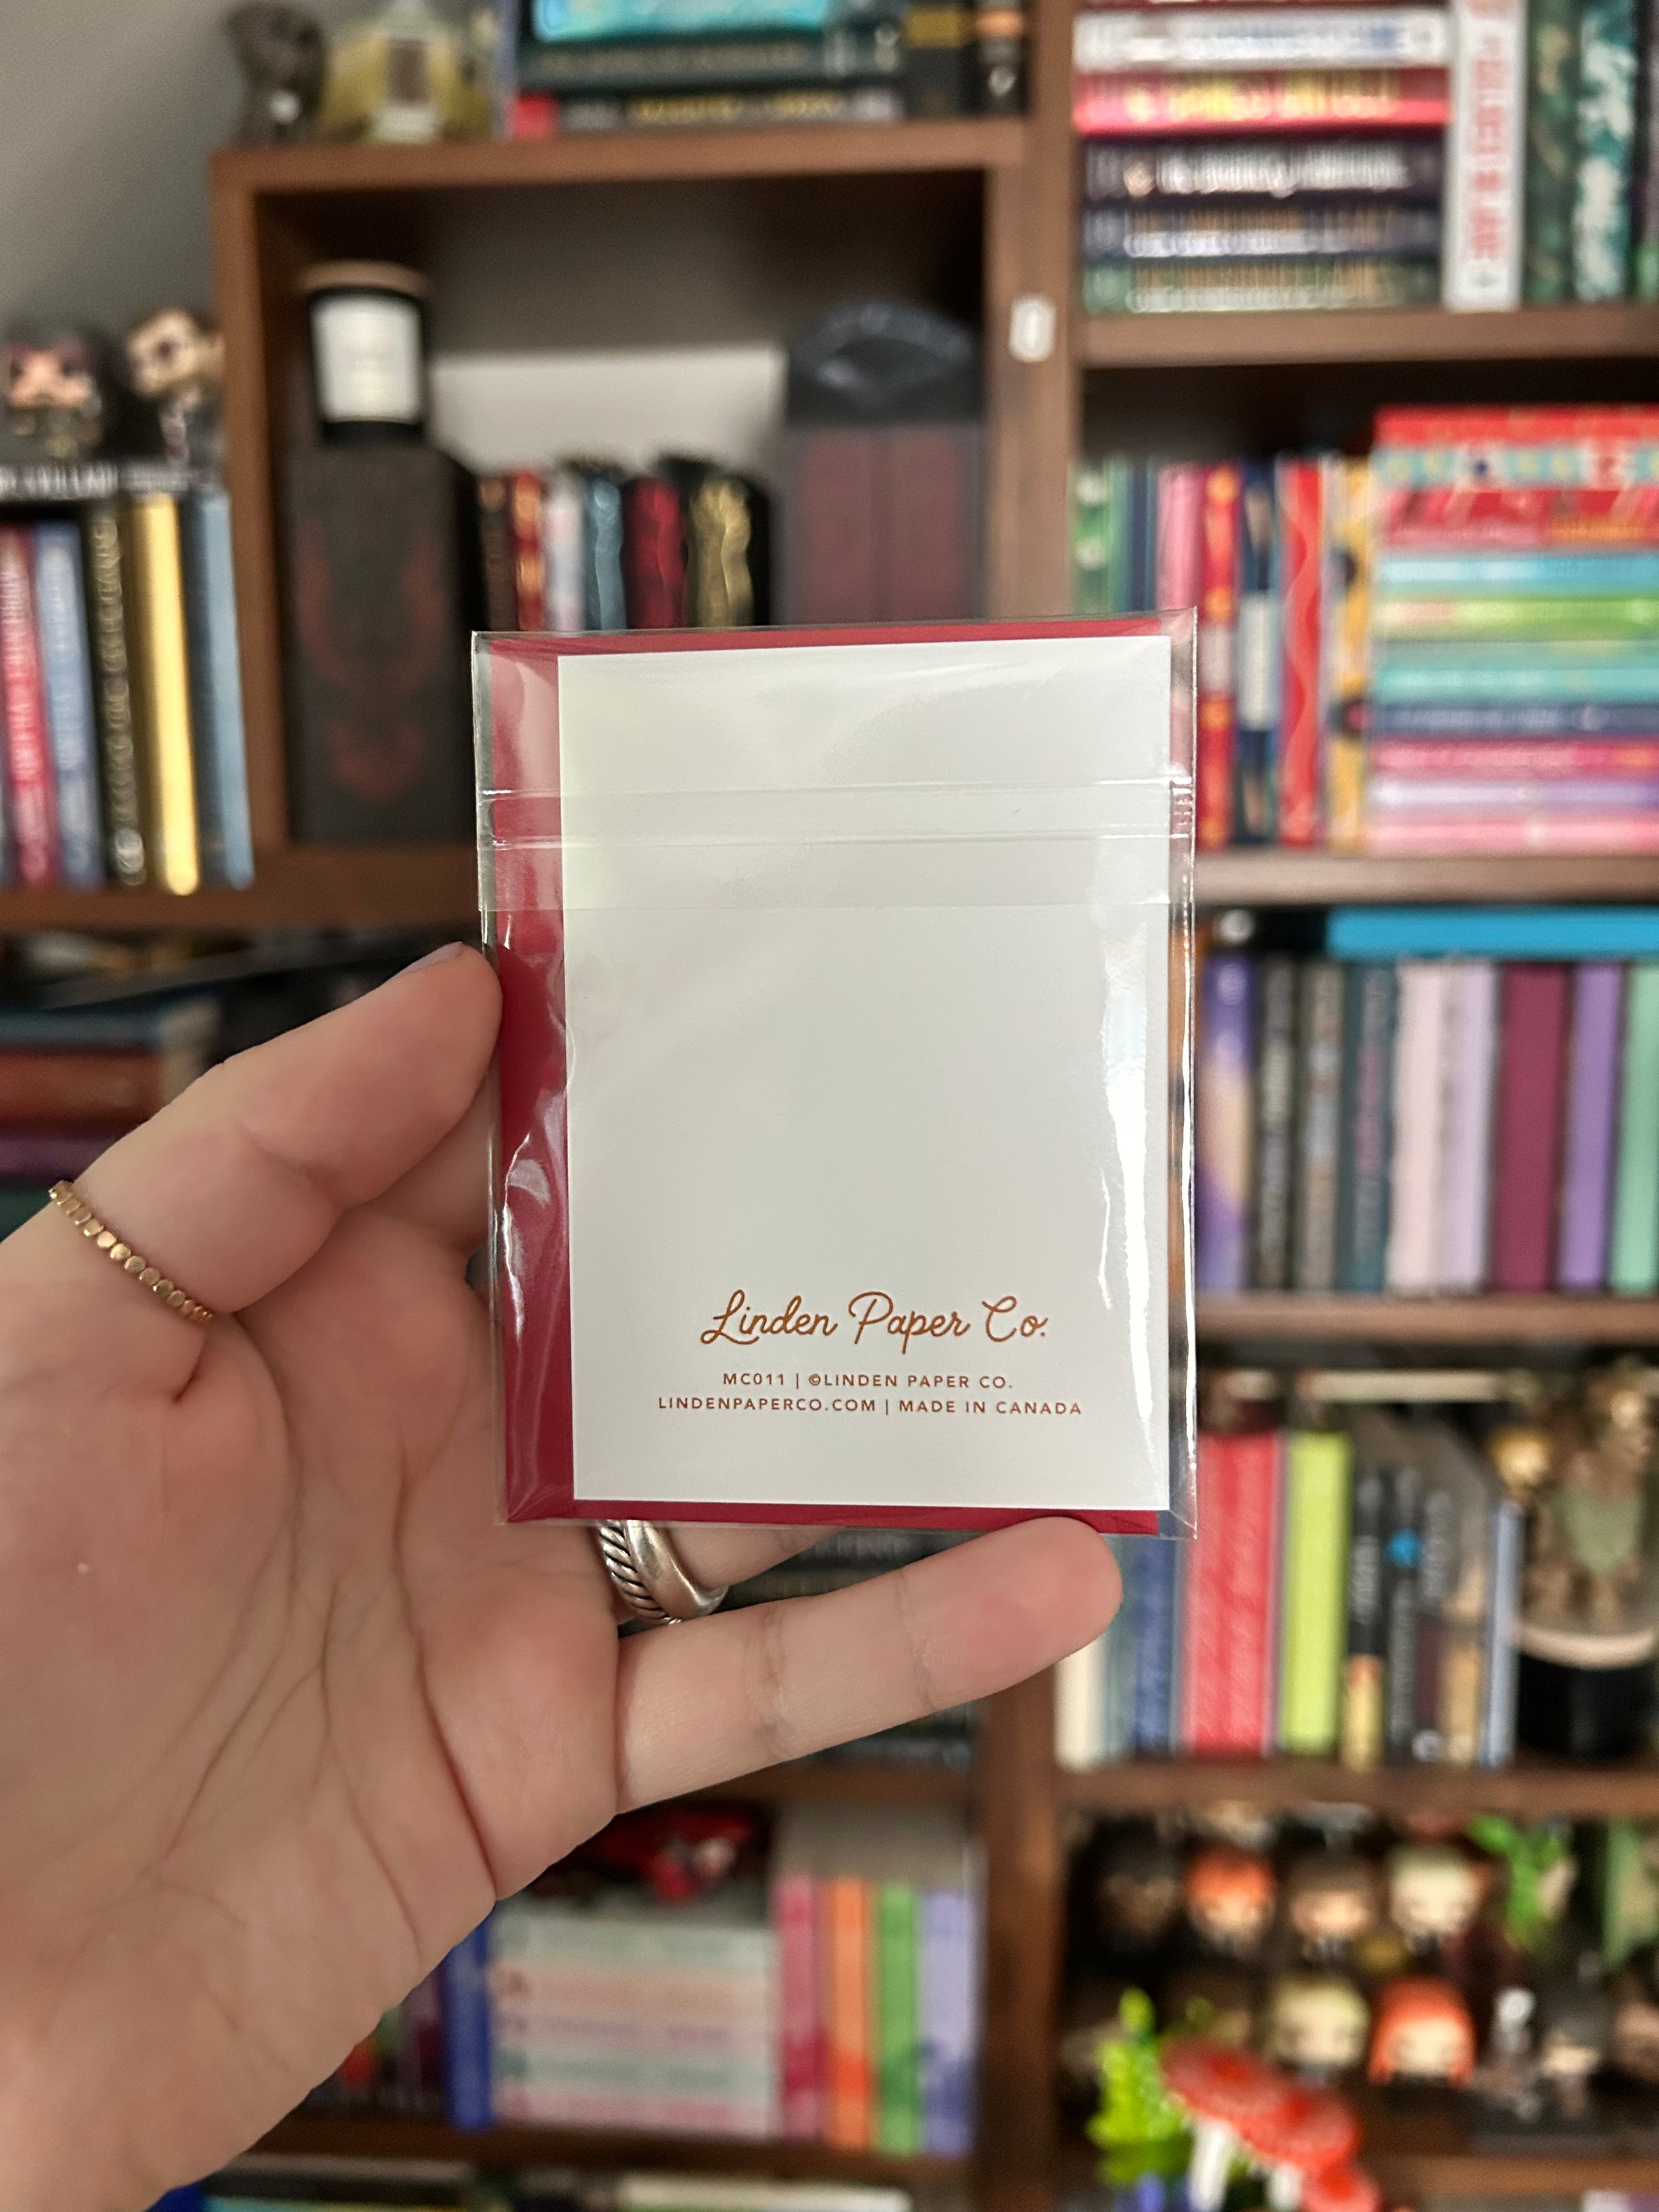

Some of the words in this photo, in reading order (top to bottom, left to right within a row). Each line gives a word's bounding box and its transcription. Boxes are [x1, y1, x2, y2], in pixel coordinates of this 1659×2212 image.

[699, 1289, 839, 1346] Linden
[847, 1291, 972, 1355] Paper
[981, 1295, 1049, 1343] Co.
[723, 1372, 784, 1386] MC011
[907, 1375, 970, 1388] PAPER
[979, 1375, 1013, 1389] CO.
[658, 1397, 875, 1412] LINDENPAPERCO.COM
[899, 1400, 956, 1414] MADE
[965, 1401, 985, 1414] IN
[995, 1401, 1082, 1415] CANADA
